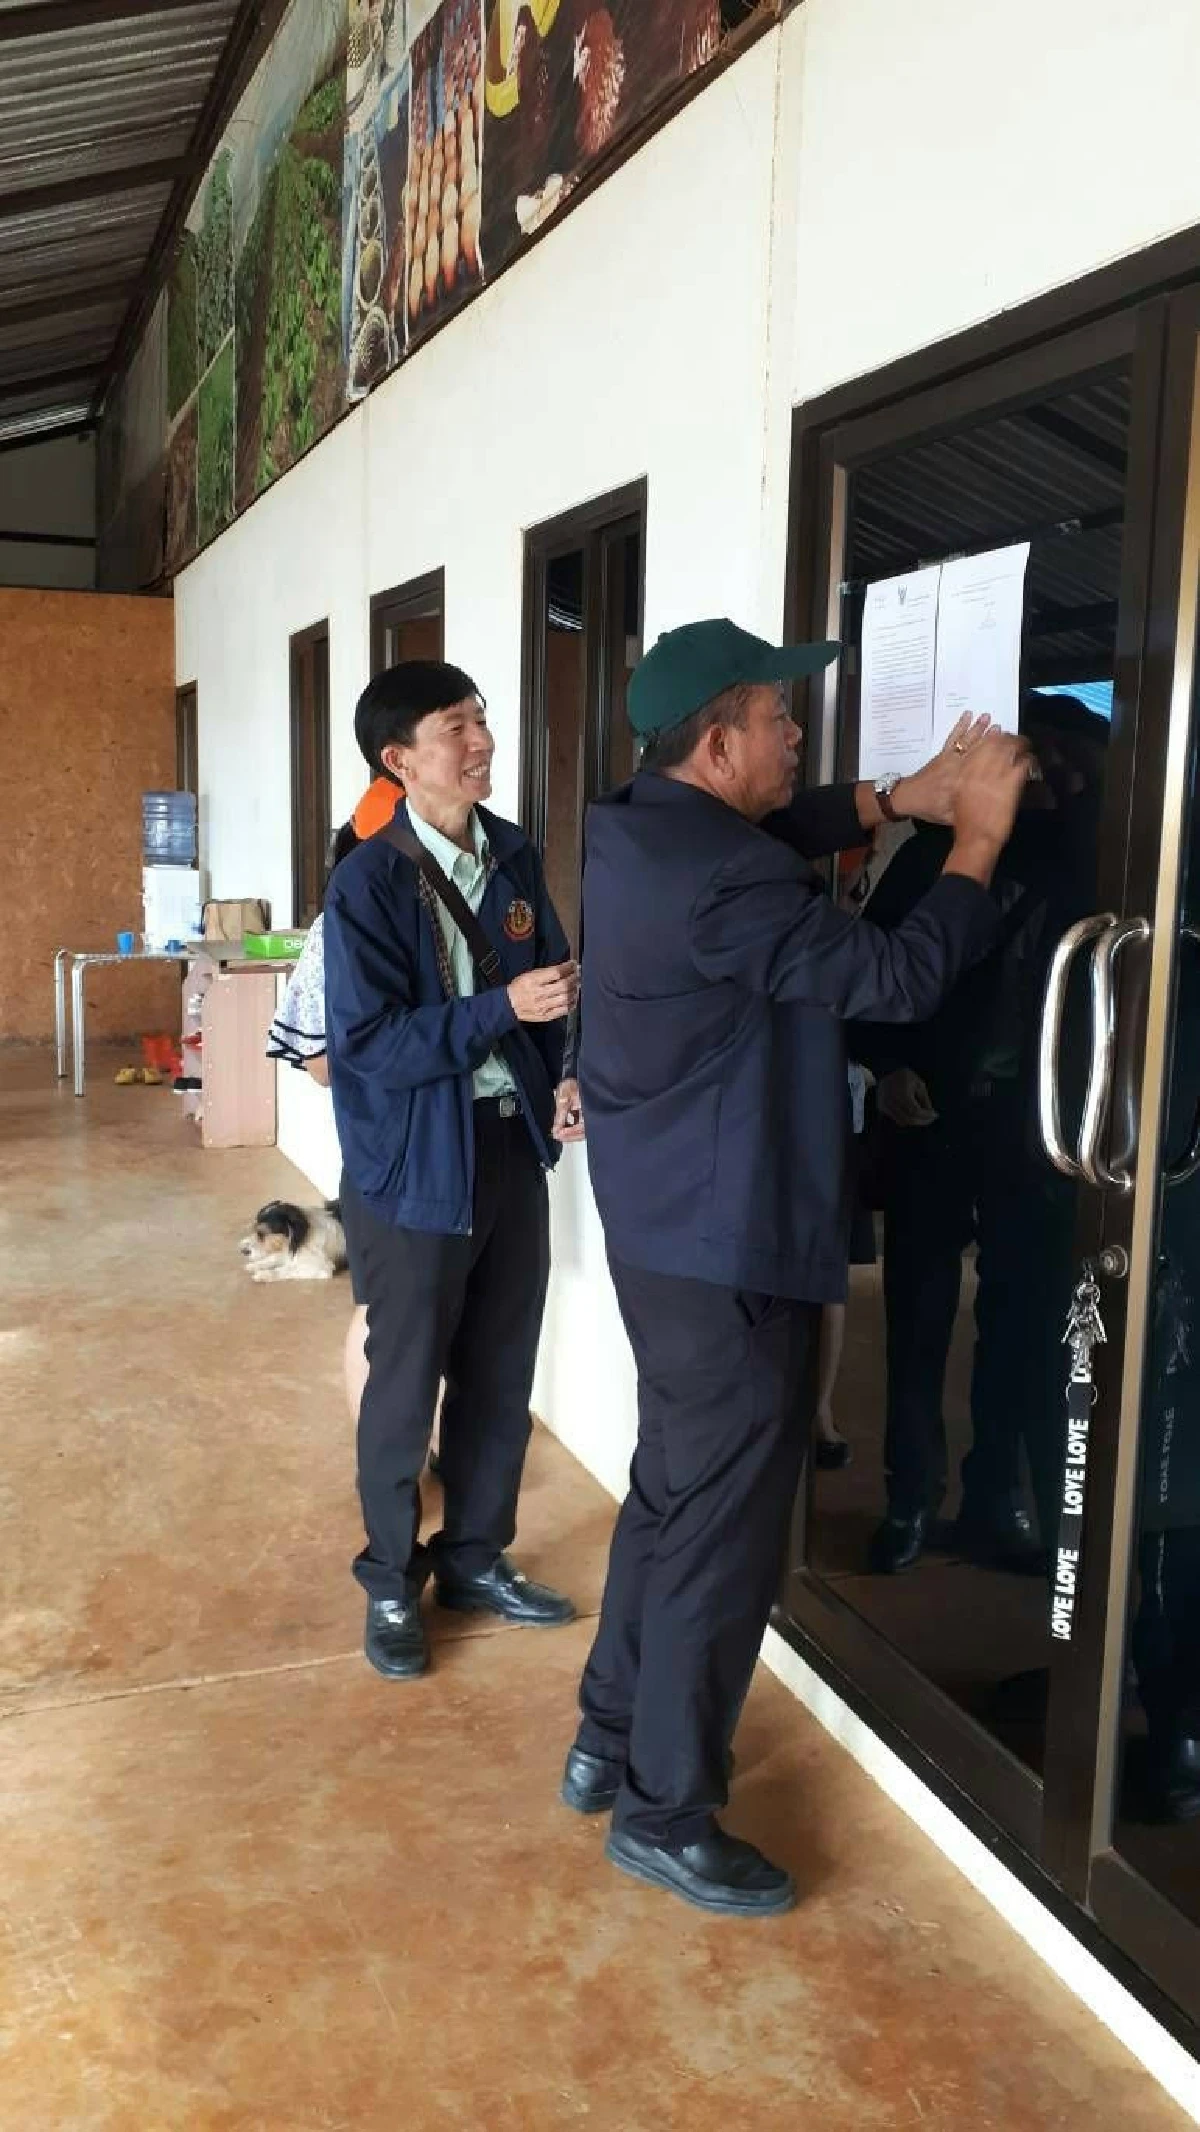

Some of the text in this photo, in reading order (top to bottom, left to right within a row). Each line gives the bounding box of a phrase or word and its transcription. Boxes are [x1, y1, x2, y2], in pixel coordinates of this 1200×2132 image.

[1062, 1418, 1089, 1515] LOVE LOVE
[1052, 1547, 1079, 1641] LOVE LOVE
